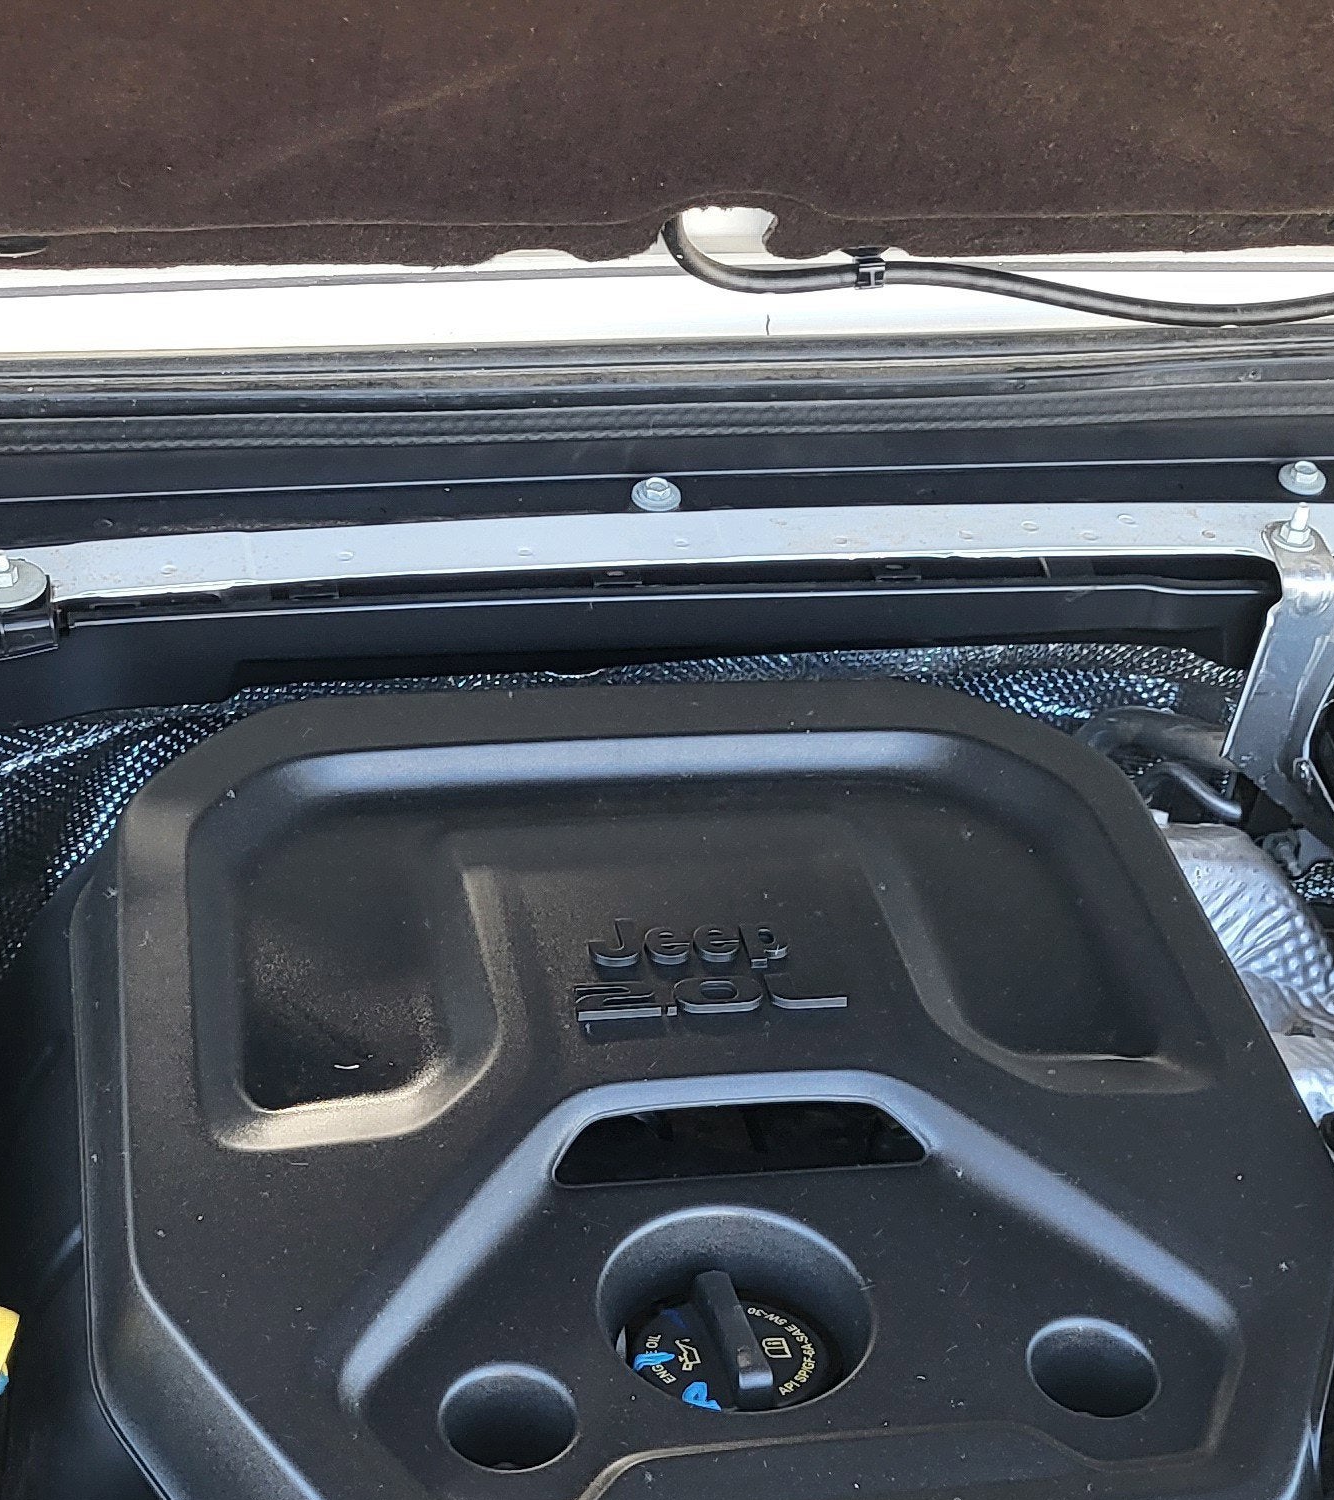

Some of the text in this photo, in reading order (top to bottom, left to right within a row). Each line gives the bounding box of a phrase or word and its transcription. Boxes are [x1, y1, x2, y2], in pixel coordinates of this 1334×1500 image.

[587, 918, 790, 969] Jeep
[573, 972, 849, 1023] 2.0L
[746, 1306, 788, 1326] 5W-30
[645, 1333, 662, 1349] OIL
[784, 1323, 810, 1345] SAE
[777, 1377, 801, 1396] API
